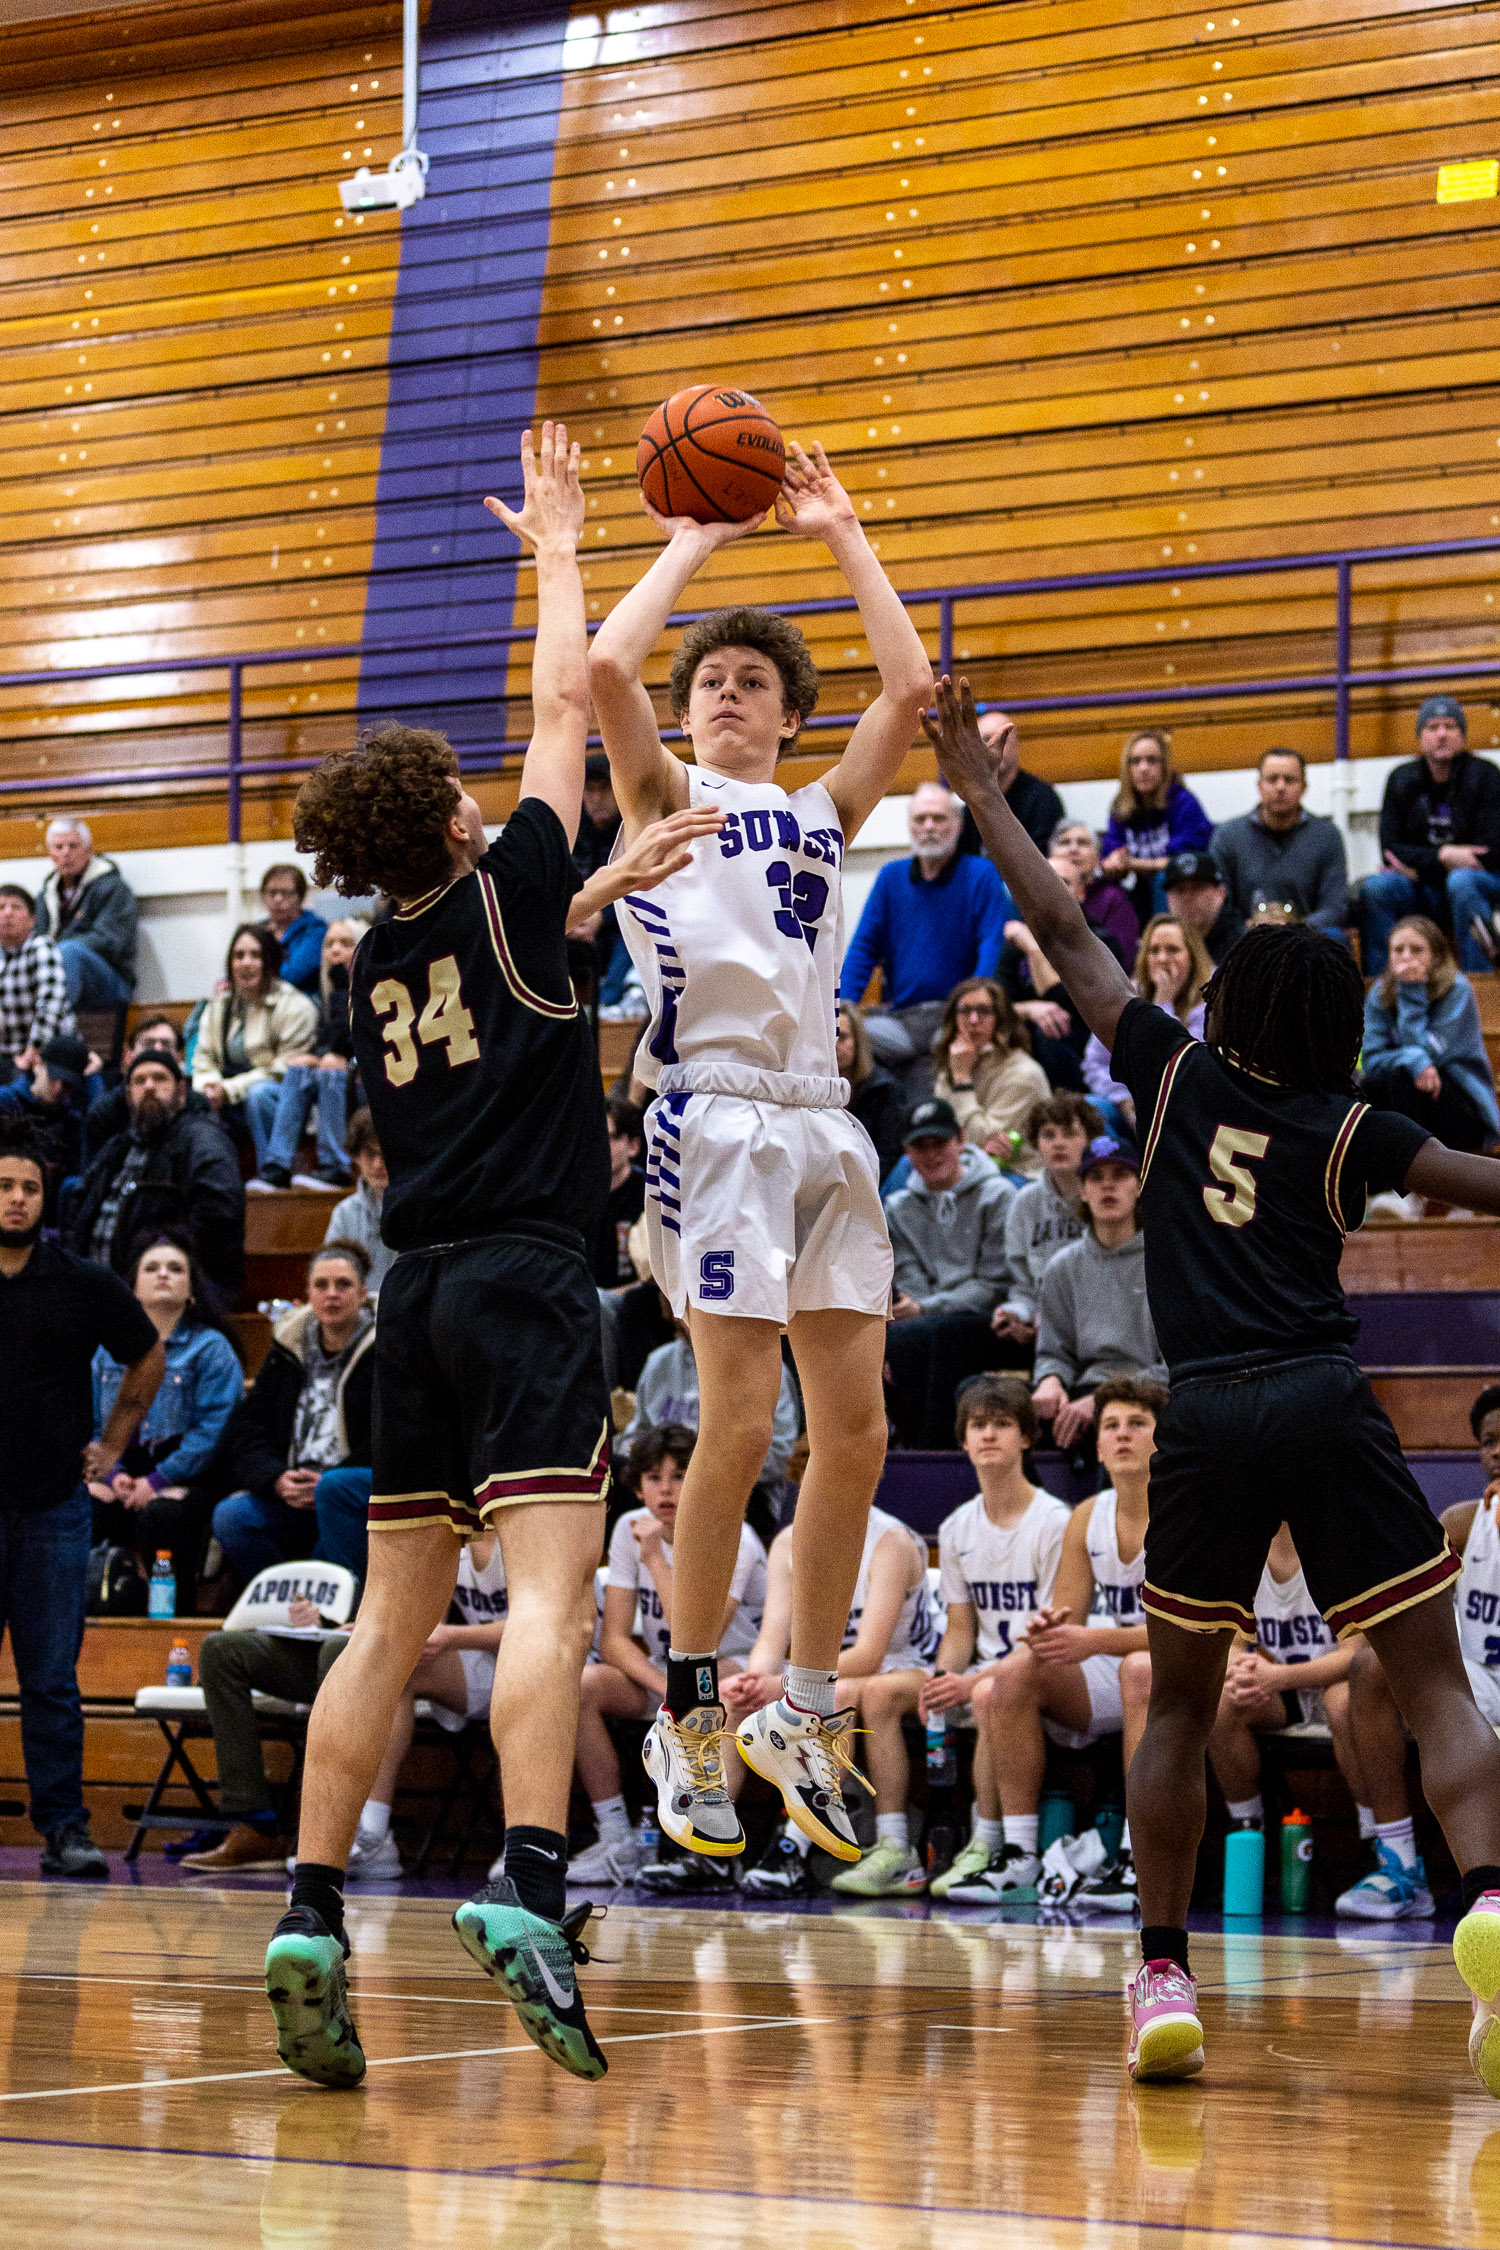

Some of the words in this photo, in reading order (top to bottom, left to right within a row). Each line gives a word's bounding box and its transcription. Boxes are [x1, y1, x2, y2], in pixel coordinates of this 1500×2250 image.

[765, 860, 829, 956] 32
[369, 953, 481, 1089] 34
[1202, 1121, 1272, 1229] 5
[699, 1250, 735, 1300] S
[246, 1579, 339, 1606] APOLLOS
